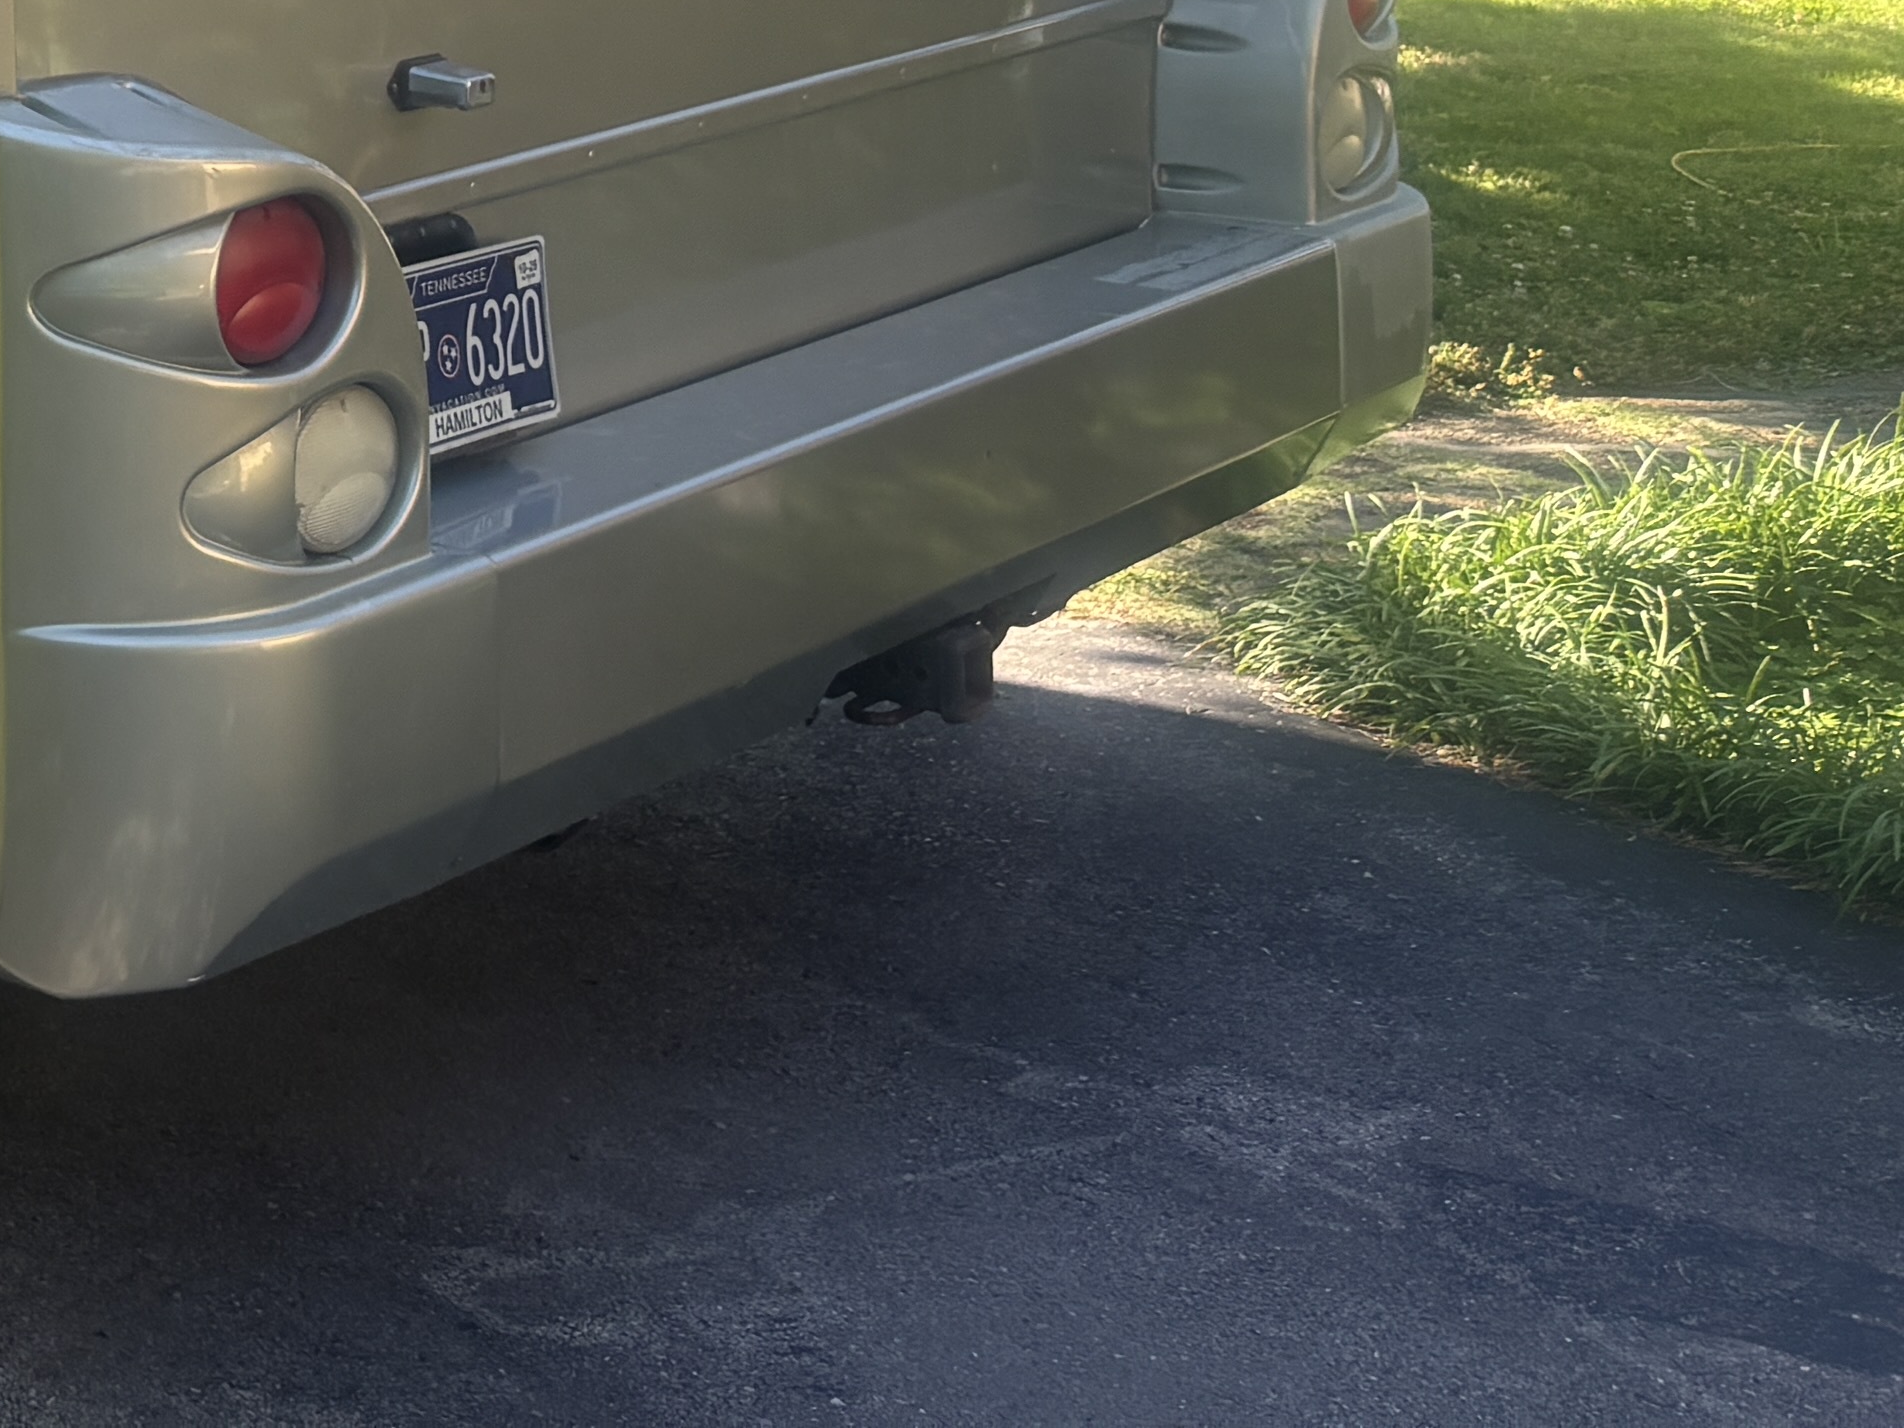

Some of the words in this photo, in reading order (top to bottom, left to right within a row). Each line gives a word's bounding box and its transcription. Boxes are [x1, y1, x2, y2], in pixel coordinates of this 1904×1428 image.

[420, 266, 487, 296] TENNESSEE
[466, 288, 544, 386] 6320
[434, 398, 504, 438] HAMILTON
